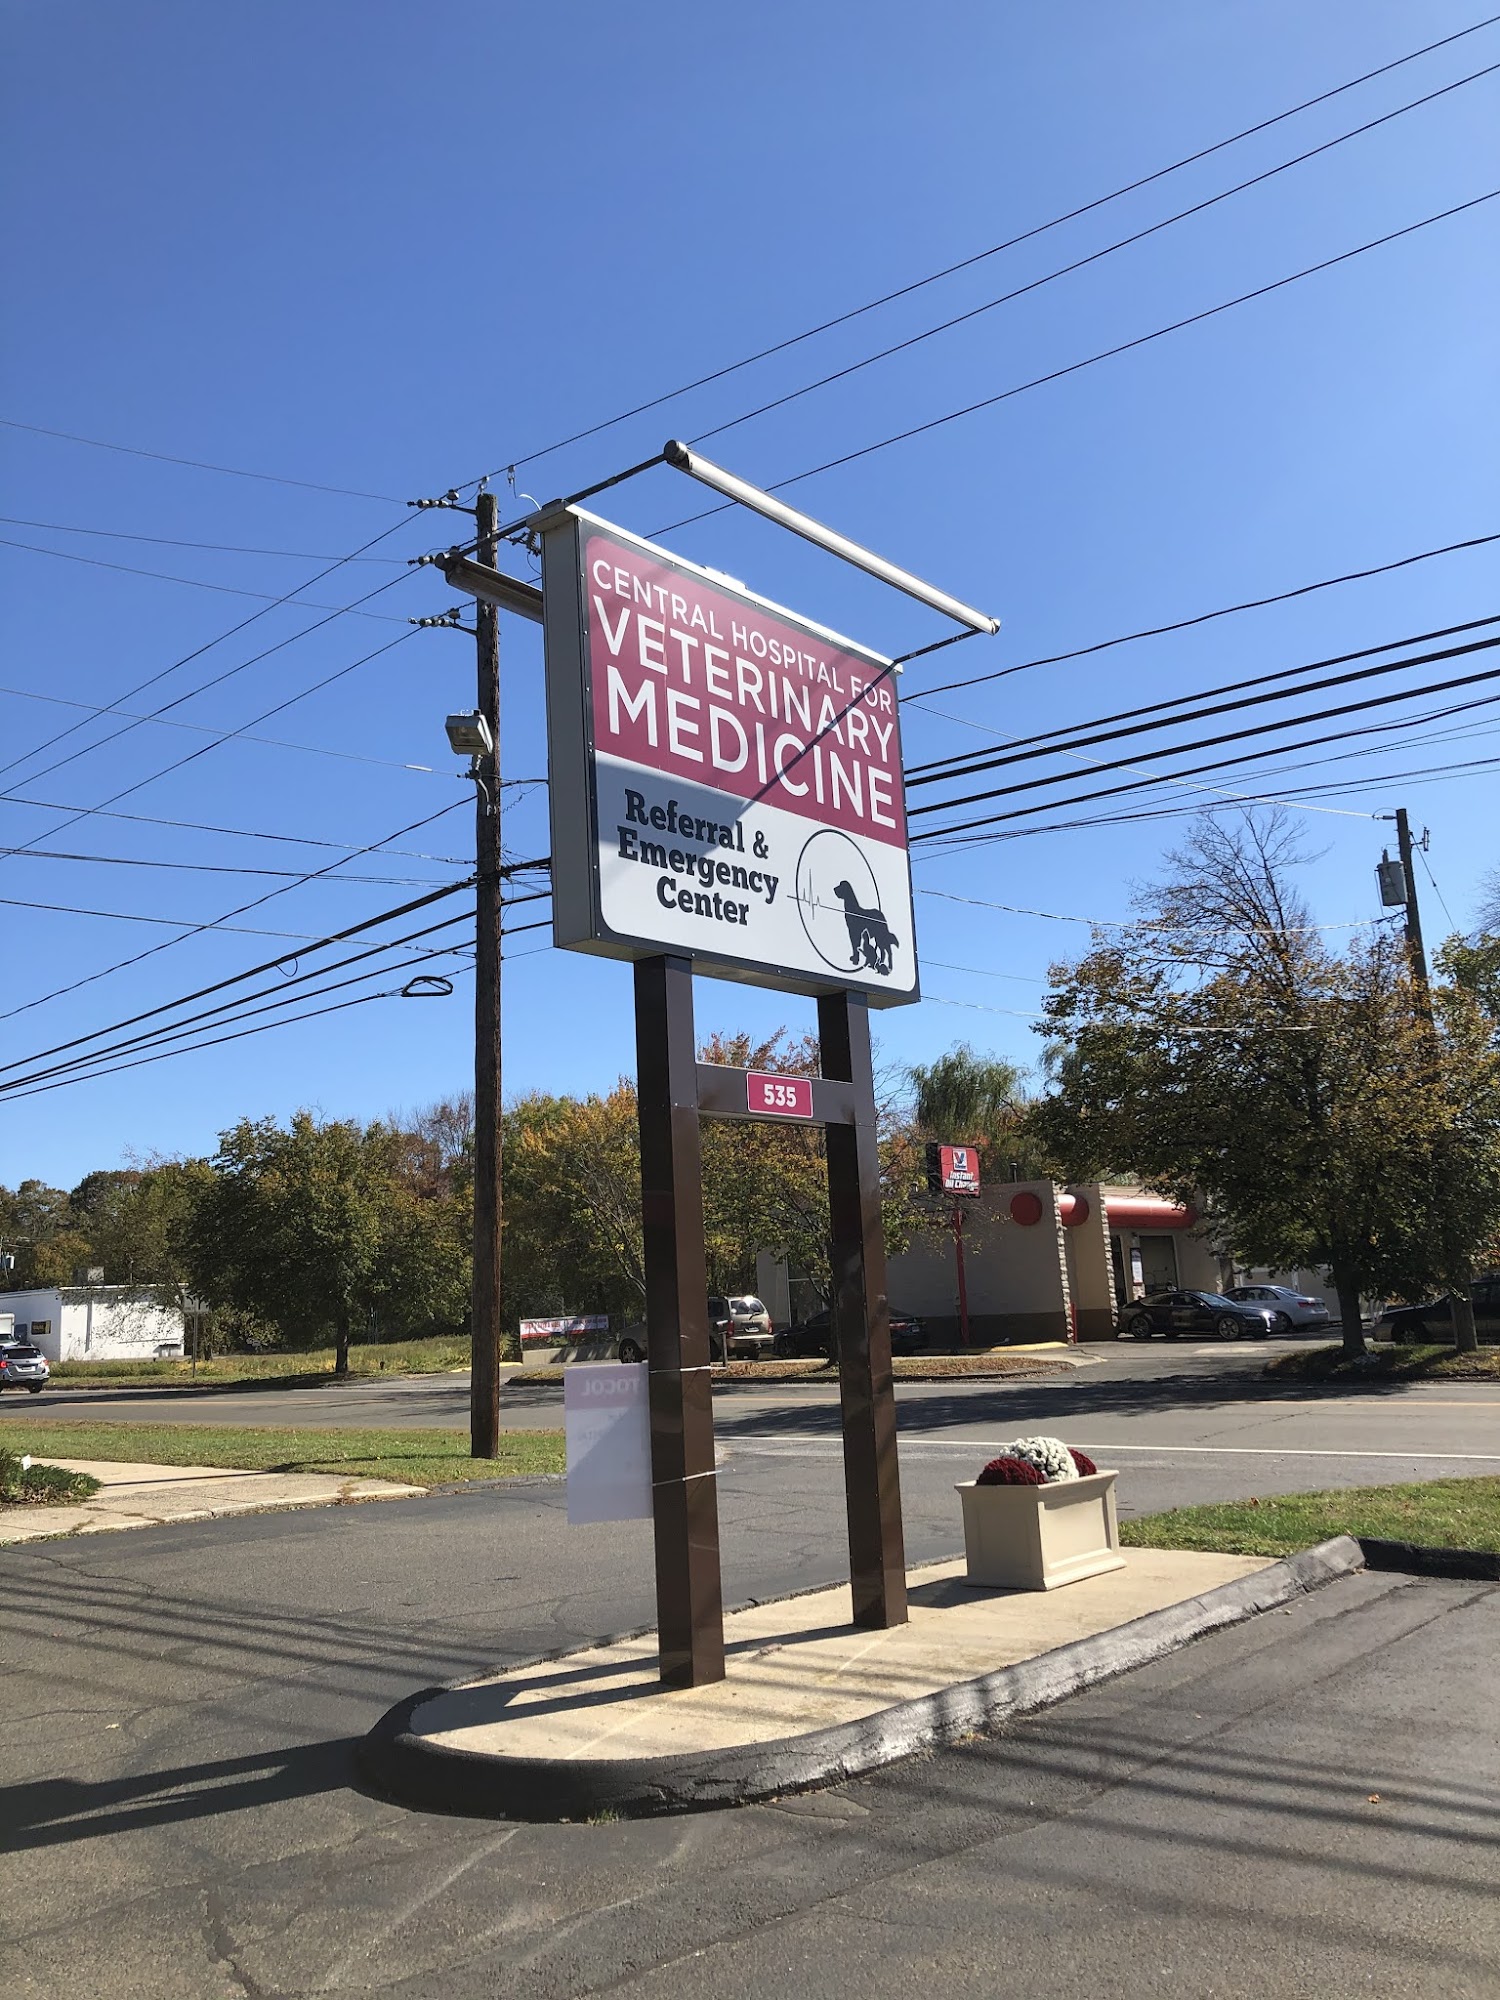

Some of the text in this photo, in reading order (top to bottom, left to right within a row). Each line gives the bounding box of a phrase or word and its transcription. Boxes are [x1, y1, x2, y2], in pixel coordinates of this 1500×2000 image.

[593, 559, 892, 715] CENTRAL HOSPITAL FOR
[593, 595, 893, 763] VETERINARY
[607, 665, 896, 829] MEDICINE
[625, 788, 769, 860] Referral &
[617, 825, 779, 905] Emergency
[656, 875, 749, 926] Center
[764, 1083, 797, 1108] 535
[949, 1170, 974, 1180] Instant
